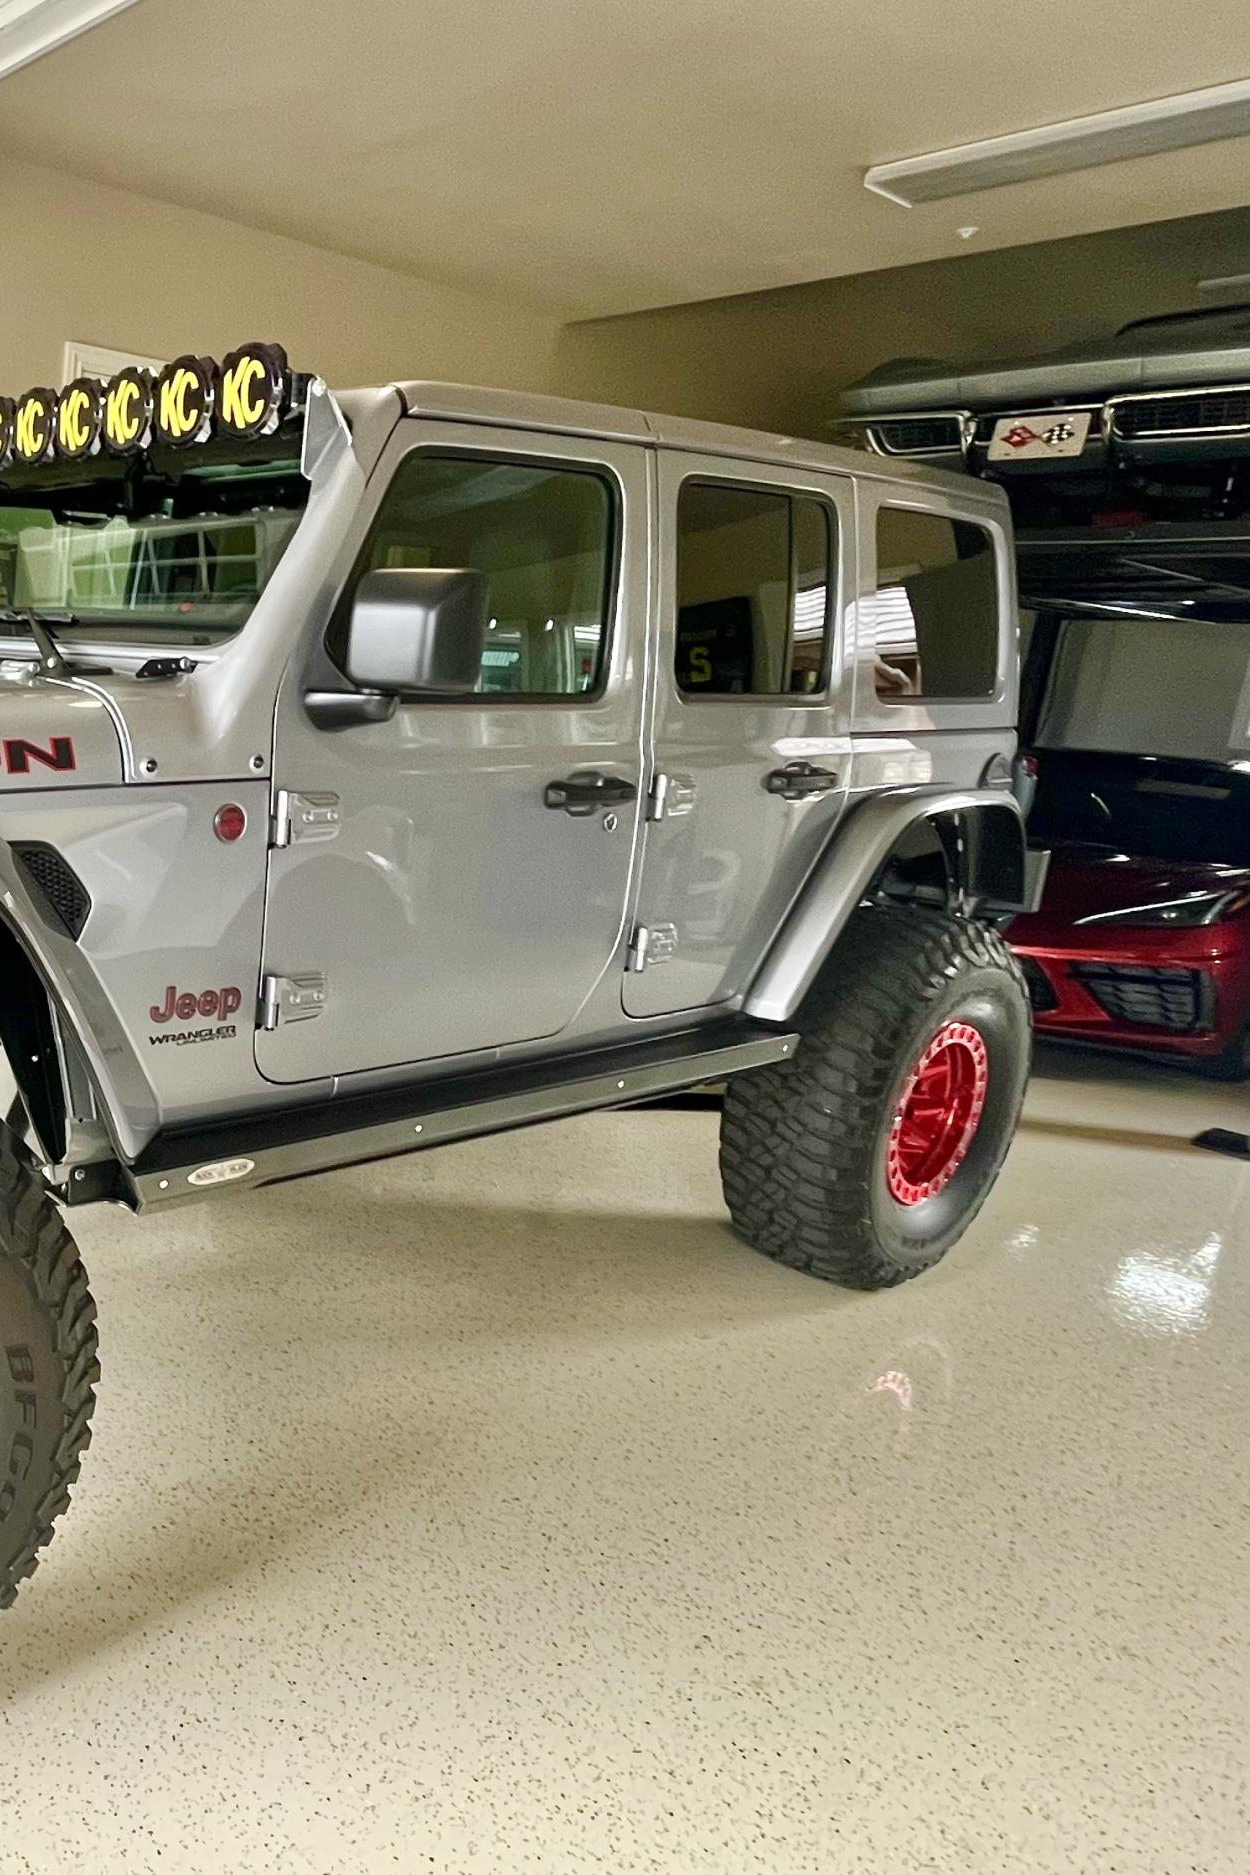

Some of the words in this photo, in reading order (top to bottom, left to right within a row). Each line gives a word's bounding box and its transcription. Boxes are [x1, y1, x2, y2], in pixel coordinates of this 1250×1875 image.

[59, 389, 90, 451] KC
[107, 379, 140, 444] KC
[160, 368, 198, 437] KC
[222, 356, 265, 429] KC
[17, 398, 43, 457] KC
[150, 985, 242, 1023] Jeep
[148, 1025, 237, 1046] WRANGLER
